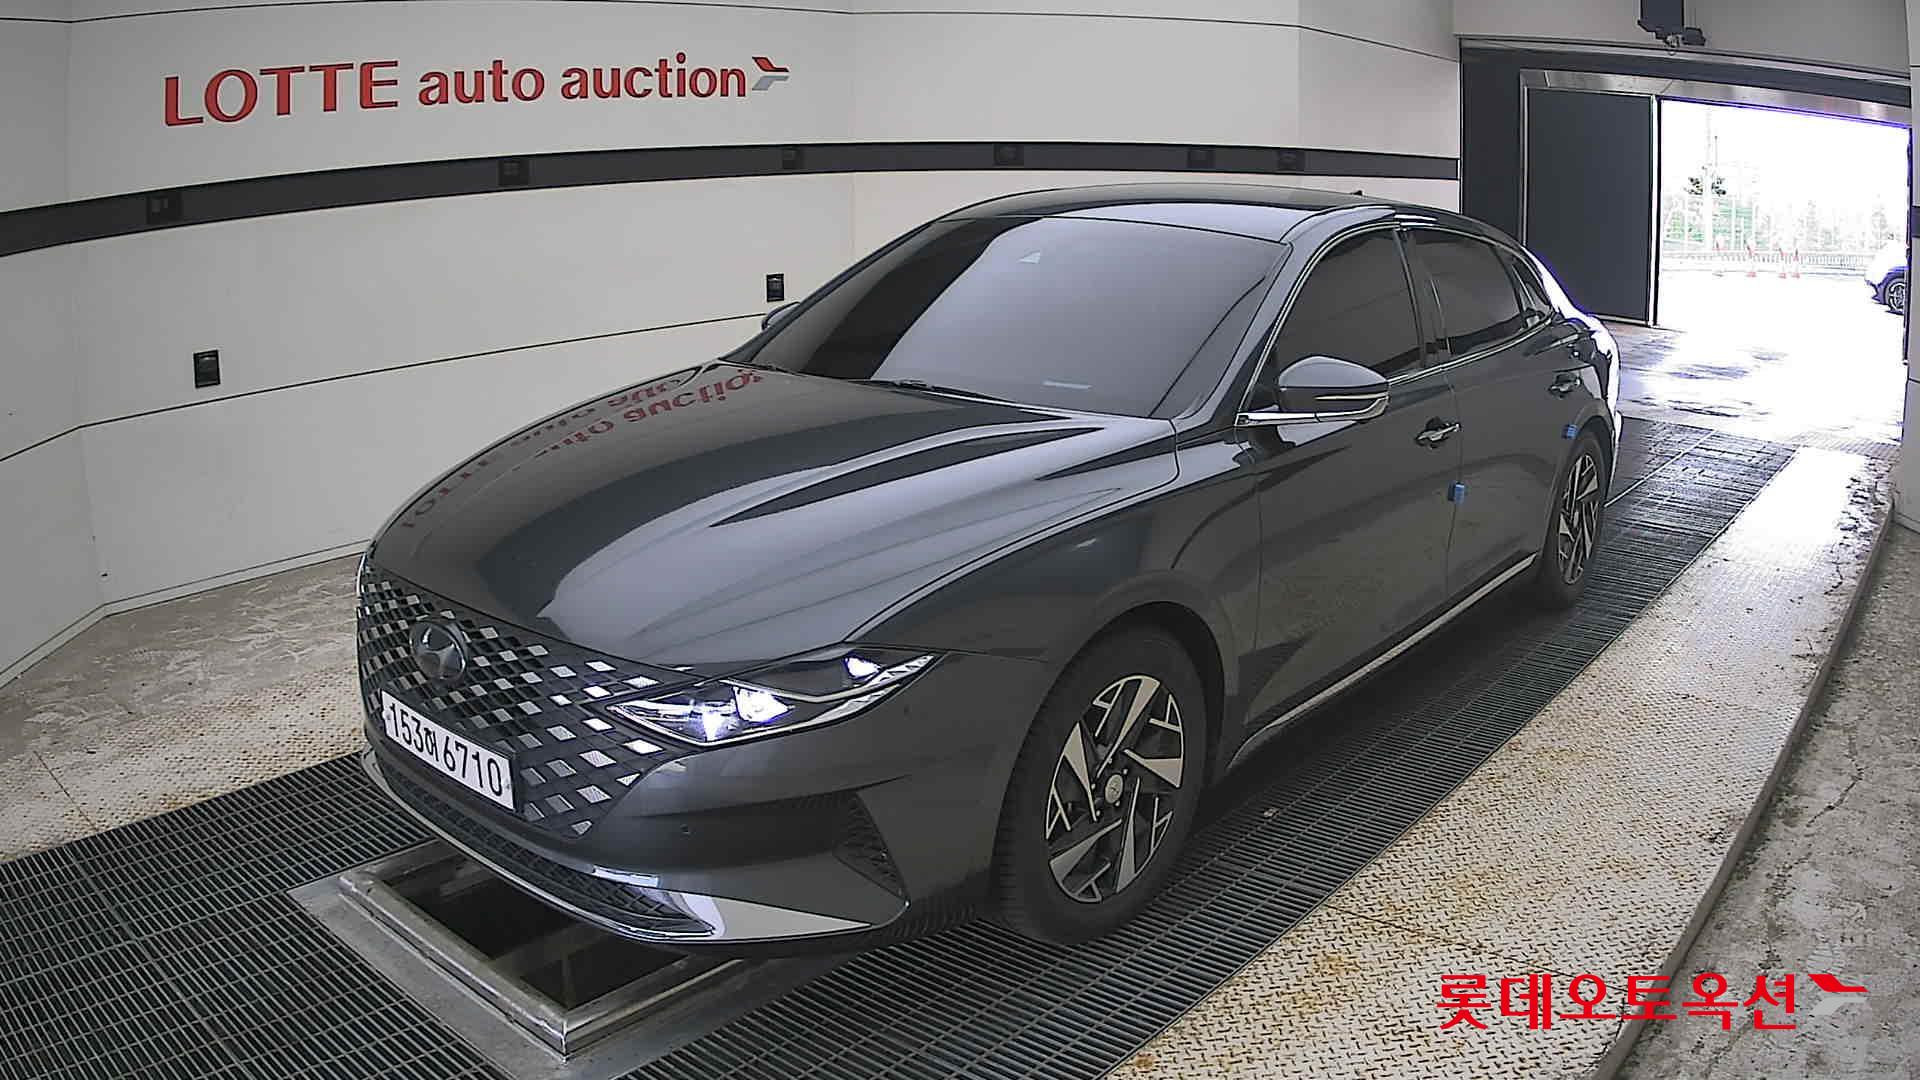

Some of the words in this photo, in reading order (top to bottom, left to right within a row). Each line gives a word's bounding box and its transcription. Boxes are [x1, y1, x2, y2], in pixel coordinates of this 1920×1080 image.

[164, 61, 399, 127] LOTTE
[417, 59, 546, 106] auto
[560, 52, 747, 99] auction
